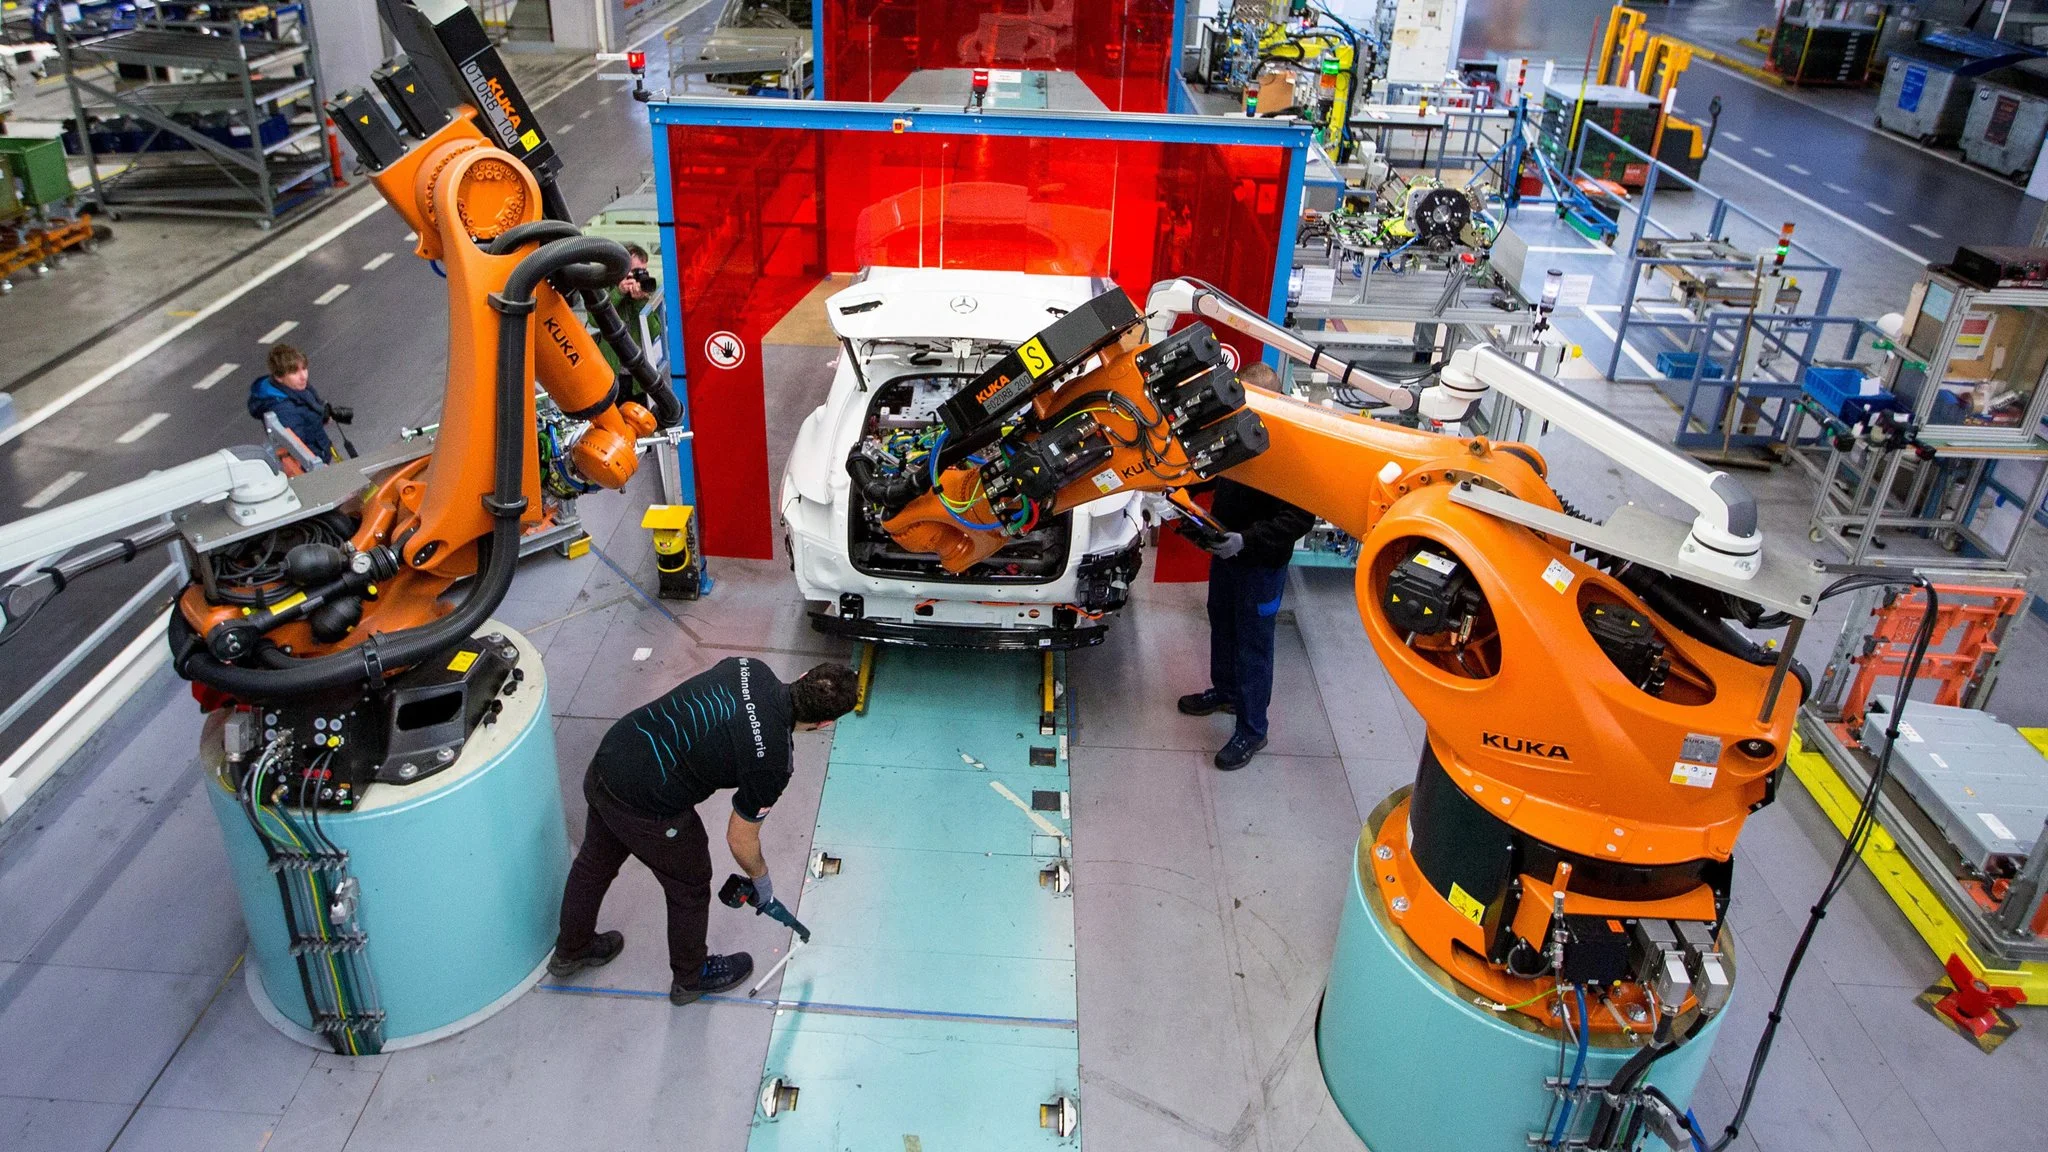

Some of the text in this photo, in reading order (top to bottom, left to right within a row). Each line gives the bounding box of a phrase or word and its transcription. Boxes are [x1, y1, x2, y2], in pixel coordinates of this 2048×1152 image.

[487, 77, 521, 130] KUKA
[525, 135, 535, 145] S
[543, 317, 580, 366] KUKA
[1026, 346, 1045, 370] S
[975, 374, 1010, 404] KUKA
[740, 667, 751, 700] können
[745, 702, 766, 758] Großserie
[1482, 731, 1570, 761] KUKA
